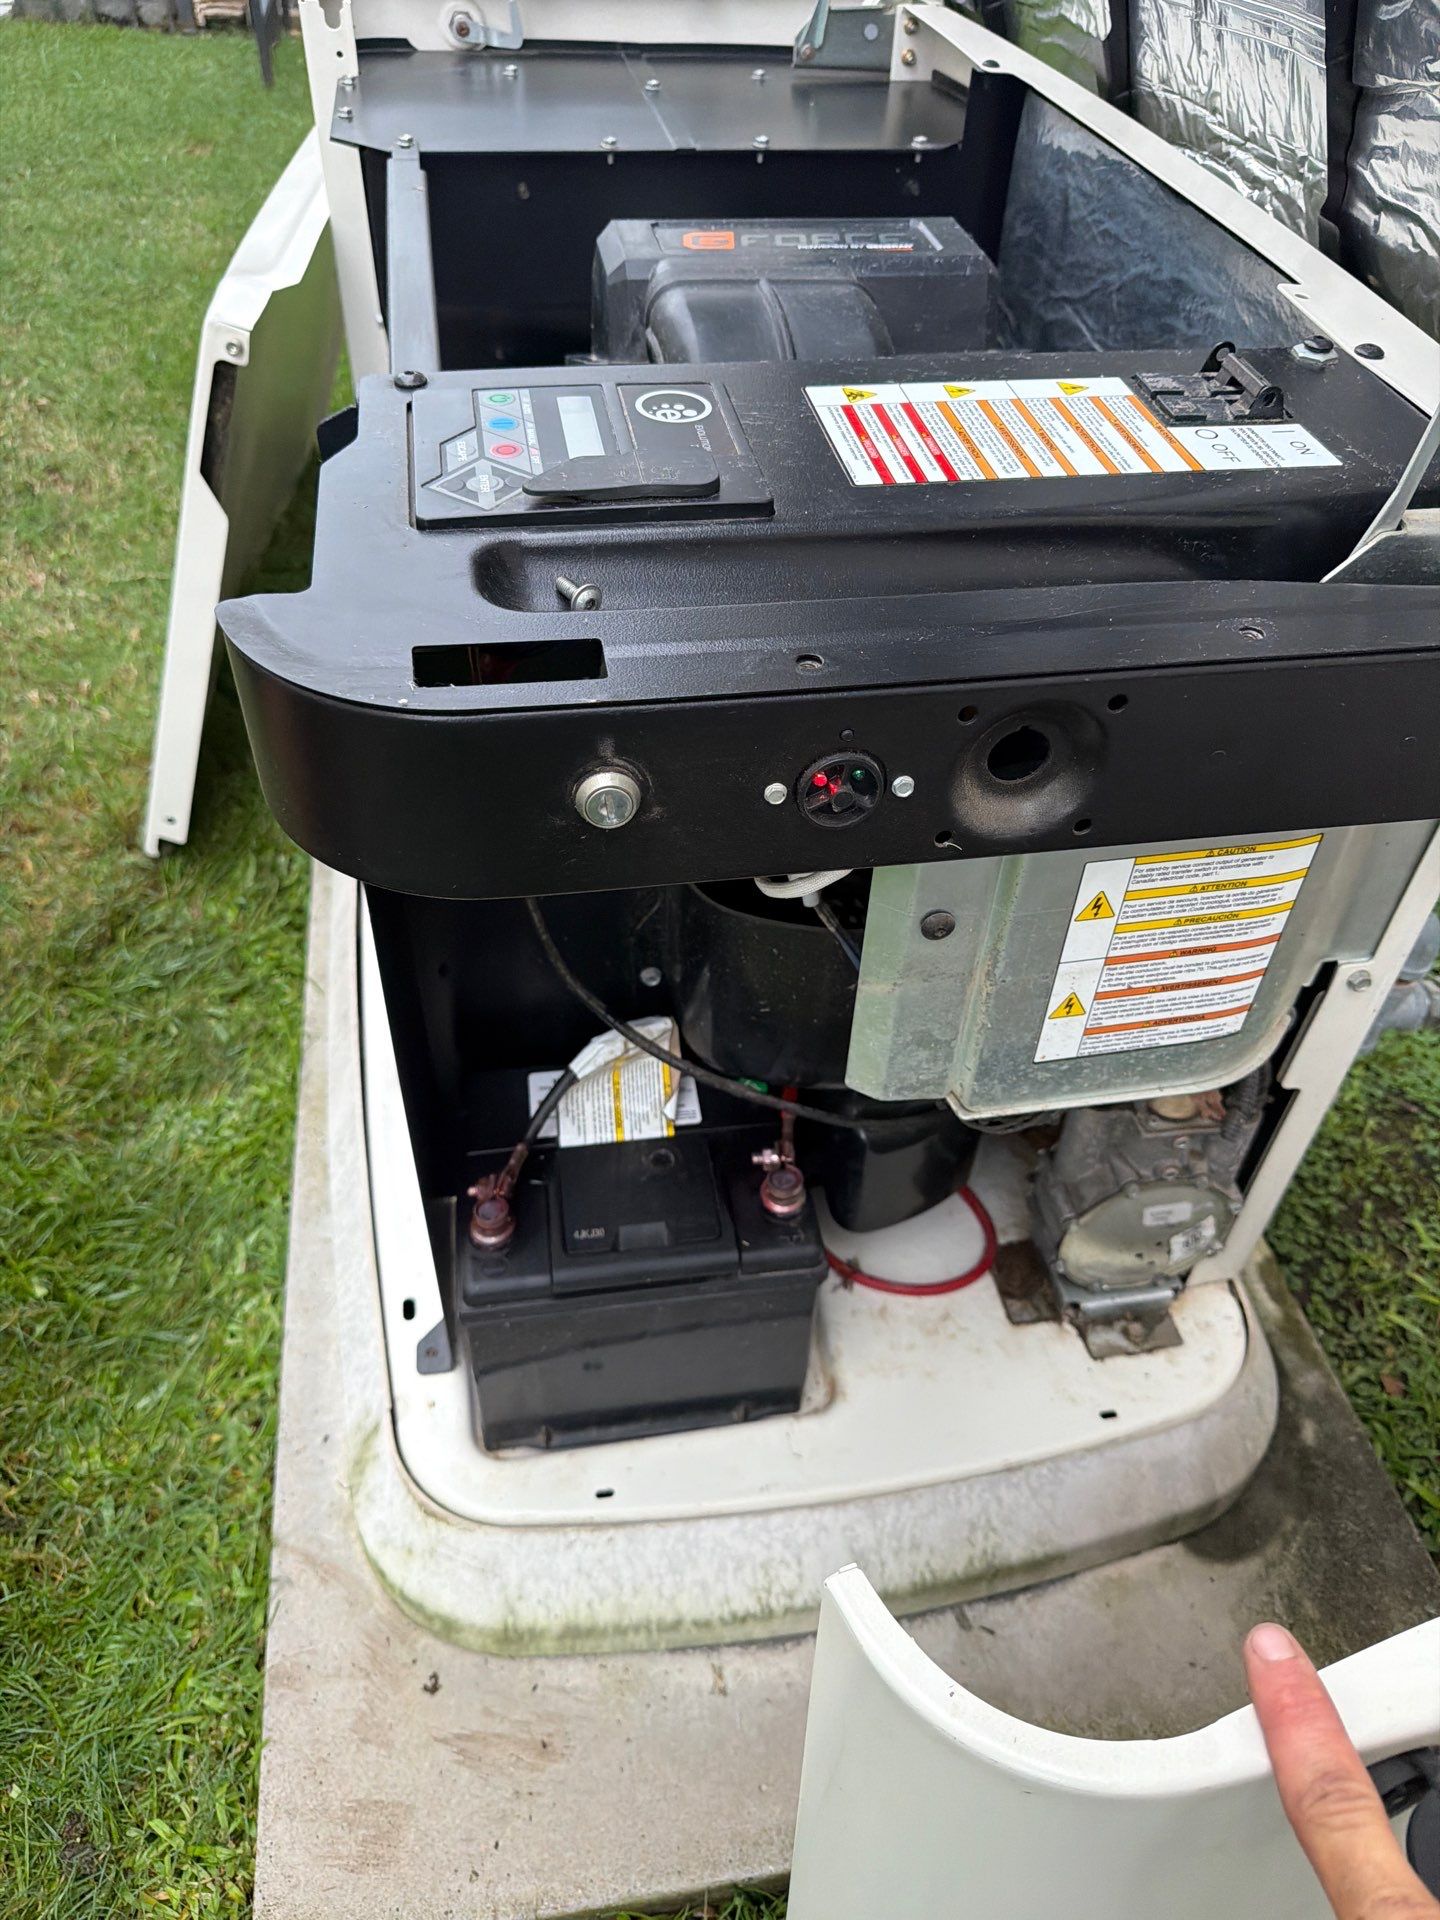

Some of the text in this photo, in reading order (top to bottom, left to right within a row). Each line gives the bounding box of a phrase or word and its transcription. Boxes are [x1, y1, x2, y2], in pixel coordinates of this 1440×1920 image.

[1212, 444, 1242, 463] OFF
[1290, 441, 1315, 455] ON
[1199, 880, 1247, 890] ATTENTION
